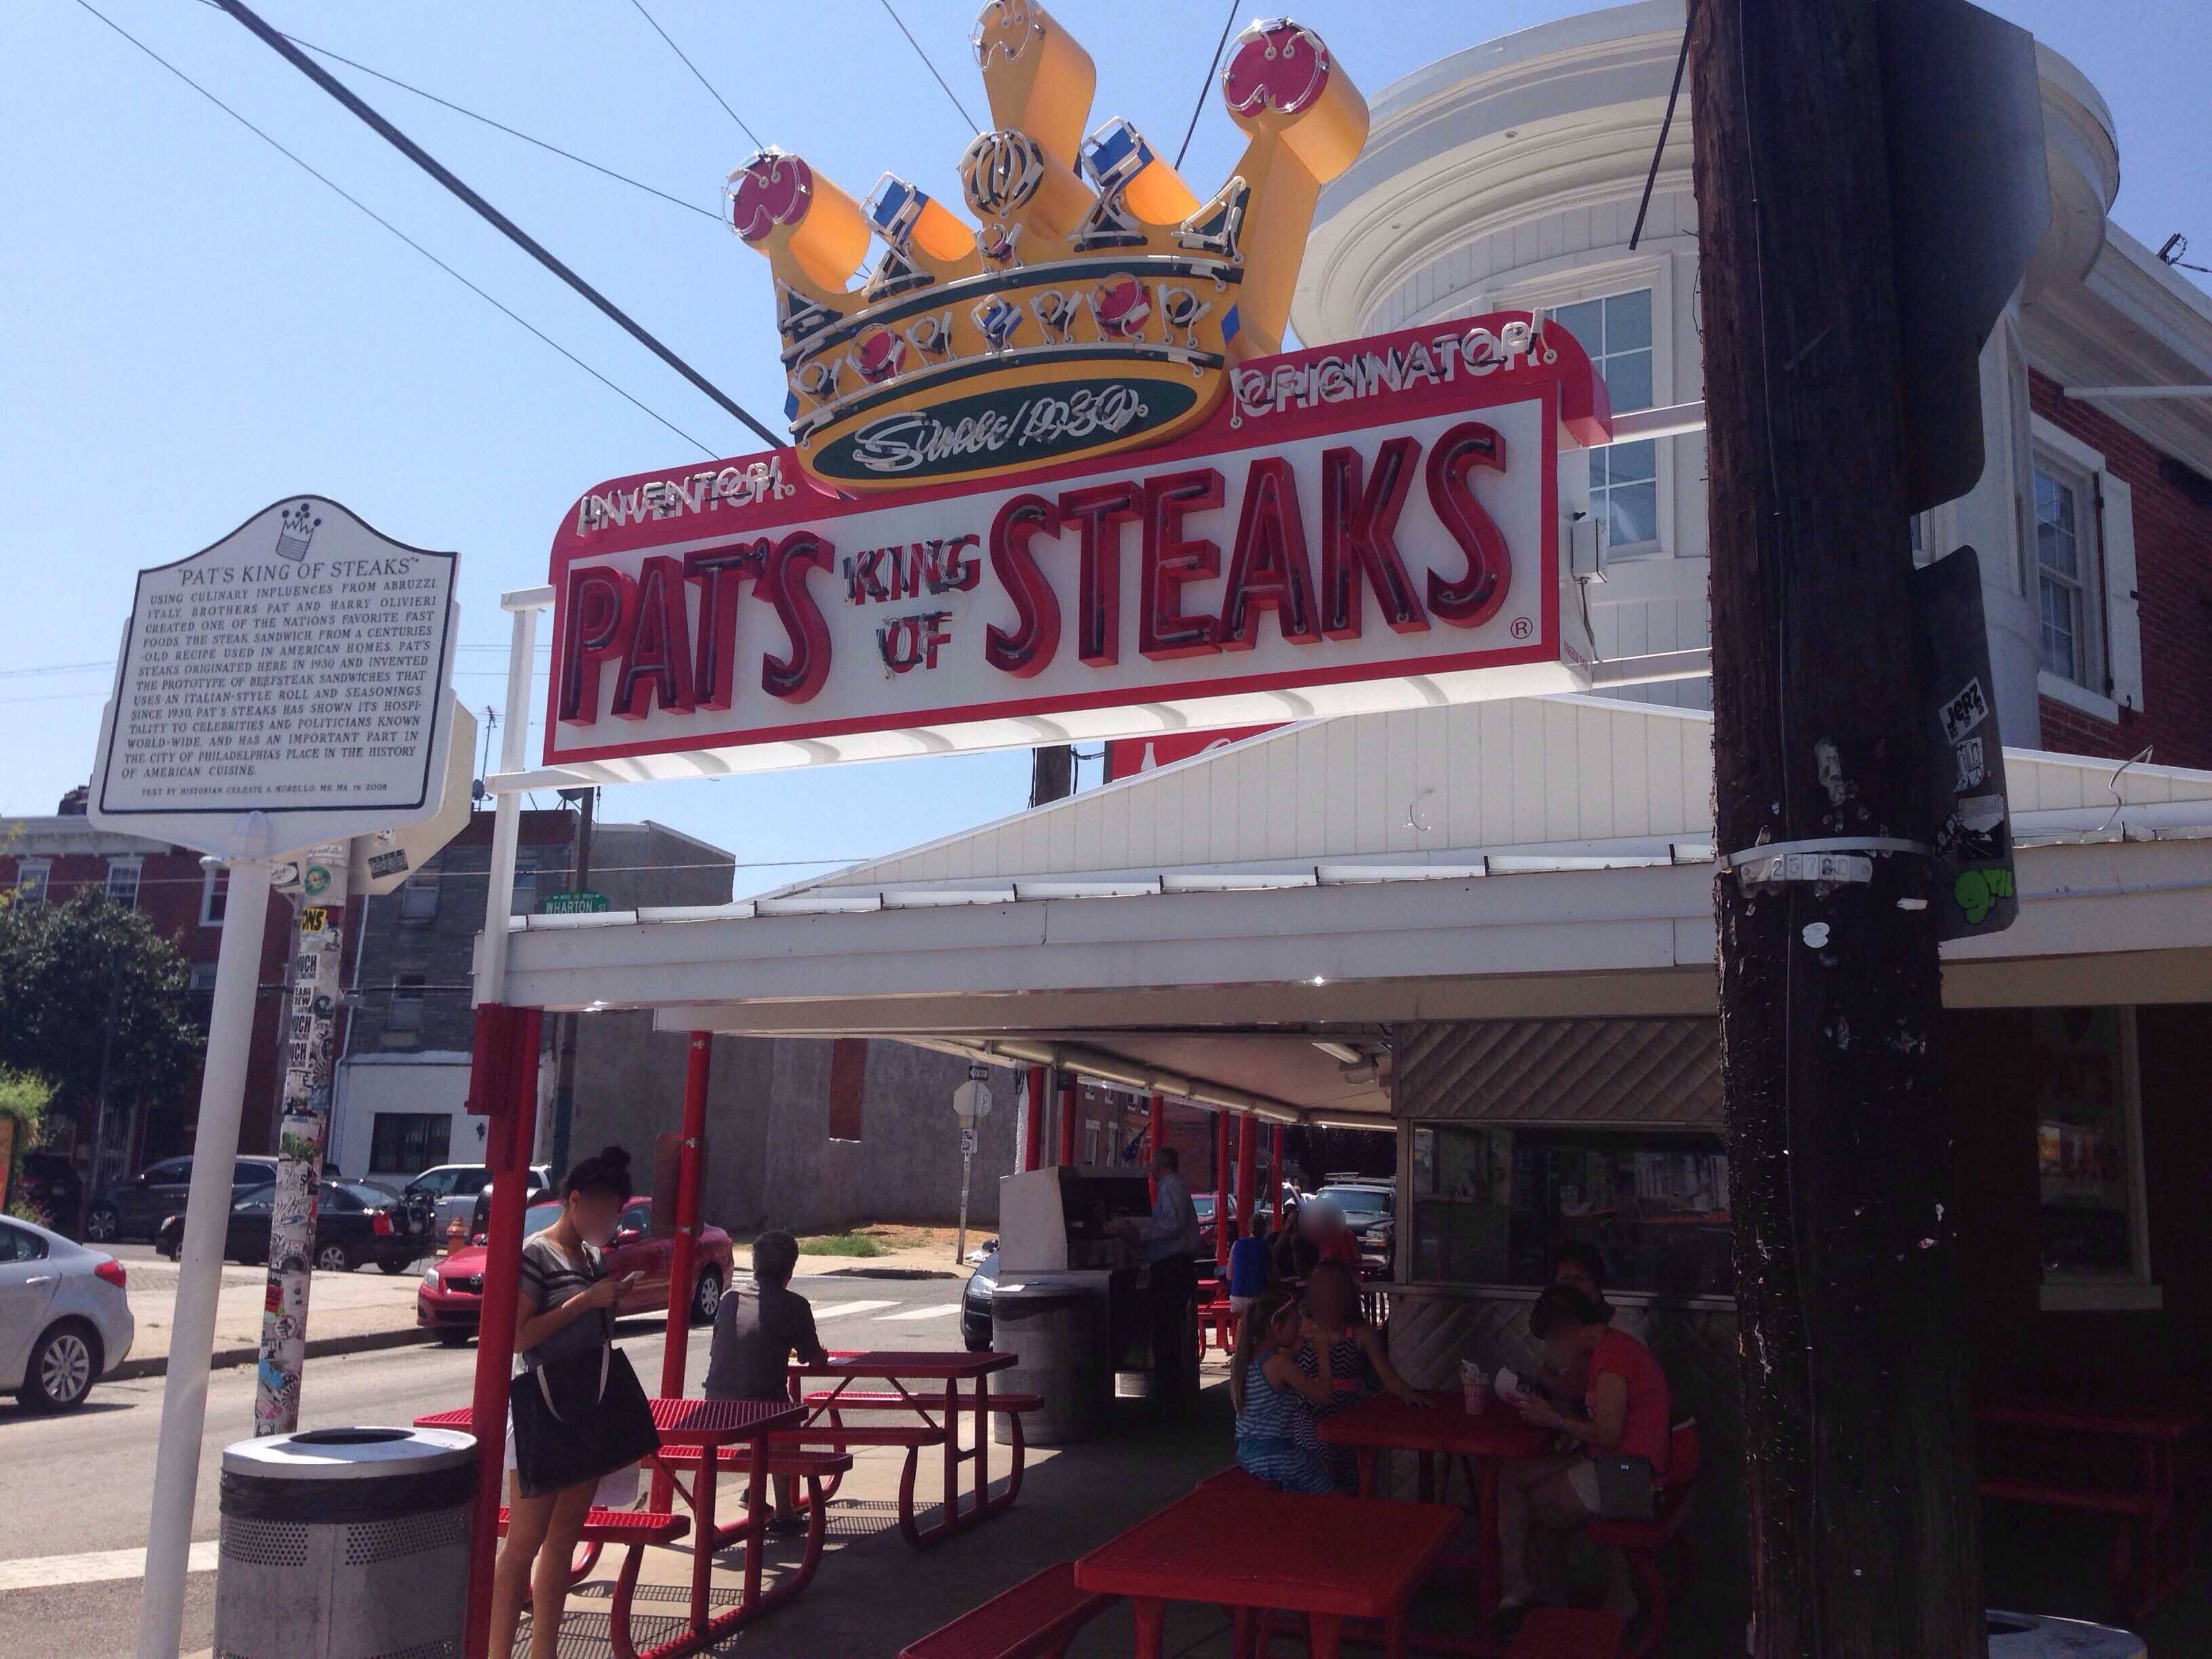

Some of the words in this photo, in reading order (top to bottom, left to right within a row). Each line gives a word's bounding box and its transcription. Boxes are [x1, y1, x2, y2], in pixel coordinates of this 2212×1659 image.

[1233, 319, 1540, 417] ORIGINATOR
[577, 456, 783, 537] INVENTOR
[986, 421, 1512, 678] STEAKS
[241, 564, 290, 583] KING
[295, 562, 325, 579] OF
[844, 534, 981, 606] KING
[150, 594, 184, 605] USING
[190, 590, 247, 603] CULINARY
[256, 584, 333, 599] INFLUENCES
[342, 581, 376, 594] FROM
[192, 605, 258, 617] BROTHERS
[267, 603, 289, 613] PAT
[296, 602, 321, 612] AND
[330, 599, 370, 611] HARRY
[380, 596, 436, 608] OLIVIERI
[145, 621, 194, 634] CREATED
[201, 620, 224, 631] ONE
[231, 619, 246, 630] OF
[253, 617, 276, 629] THE
[342, 613, 398, 625] FAVORITE
[405, 611, 434, 622] FAST
[560, 531, 835, 726] PAT'S
[185, 635, 207, 646] THE
[212, 634, 248, 645] STEAK
[319, 629, 350, 640] FROM
[355, 628, 362, 638] A
[367, 626, 432, 638] CENTURIES
[876, 611, 954, 674] OF
[175, 649, 216, 660] RECIPE
[224, 648, 254, 658] USED
[261, 647, 273, 657] IN
[280, 644, 339, 656] AMERICAN
[398, 640, 430, 651] PAT'S
[138, 664, 180, 676] STEAKS
[184, 661, 252, 674] ORIGINATED
[257, 660, 287, 672] HERE
[293, 659, 305, 670] IN
[310, 658, 335, 670] 1930
[340, 657, 363, 668] AND
[369, 654, 428, 668] INVENTED
[136, 680, 157, 691] THE
[162, 678, 225, 689] PROTOTYPE
[230, 677, 245, 687] OF
[249, 674, 314, 687] BEEFSTEAK
[319, 672, 390, 684] SANDWICHES
[395, 670, 426, 681] THAT
[133, 695, 161, 706] USES
[165, 694, 178, 705] AN
[184, 691, 271, 704] ITALIAN-STYLE
[279, 689, 308, 701] ROLL
[314, 688, 337, 699] AND
[130, 709, 163, 721] SINCE
[196, 707, 226, 718] PAT'S
[230, 705, 276, 718] STEAKS
[282, 704, 304, 716] HAS
[310, 702, 352, 714] SHOWN
[358, 701, 377, 713] ITS
[129, 724, 165, 735] TALITY
[171, 723, 186, 733] TO
[192, 721, 264, 733] CELEBRITIES
[269, 720, 291, 730] AND
[298, 718, 371, 729] POLITICIANS
[377, 716, 419, 726] KNOWN
[209, 736, 232, 747] AND
[239, 735, 260, 746] HAS
[266, 735, 281, 745] AN
[288, 733, 359, 745] IMPORTANT
[366, 732, 396, 743] PART
[405, 731, 418, 741] IN
[123, 754, 145, 763] THE
[150, 753, 173, 762] CITY
[179, 752, 192, 762] OF
[286, 749, 319, 759] PLACE
[324, 749, 335, 758] IN
[340, 748, 363, 758] THE
[369, 747, 415, 757] HISTORY
[121, 769, 136, 778] OF
[144, 767, 201, 777] AMERICAN
[180, 787, 222, 795] HISTORIAN
[546, 901, 592, 914] WHARTON
[598, 904, 607, 912] ST
